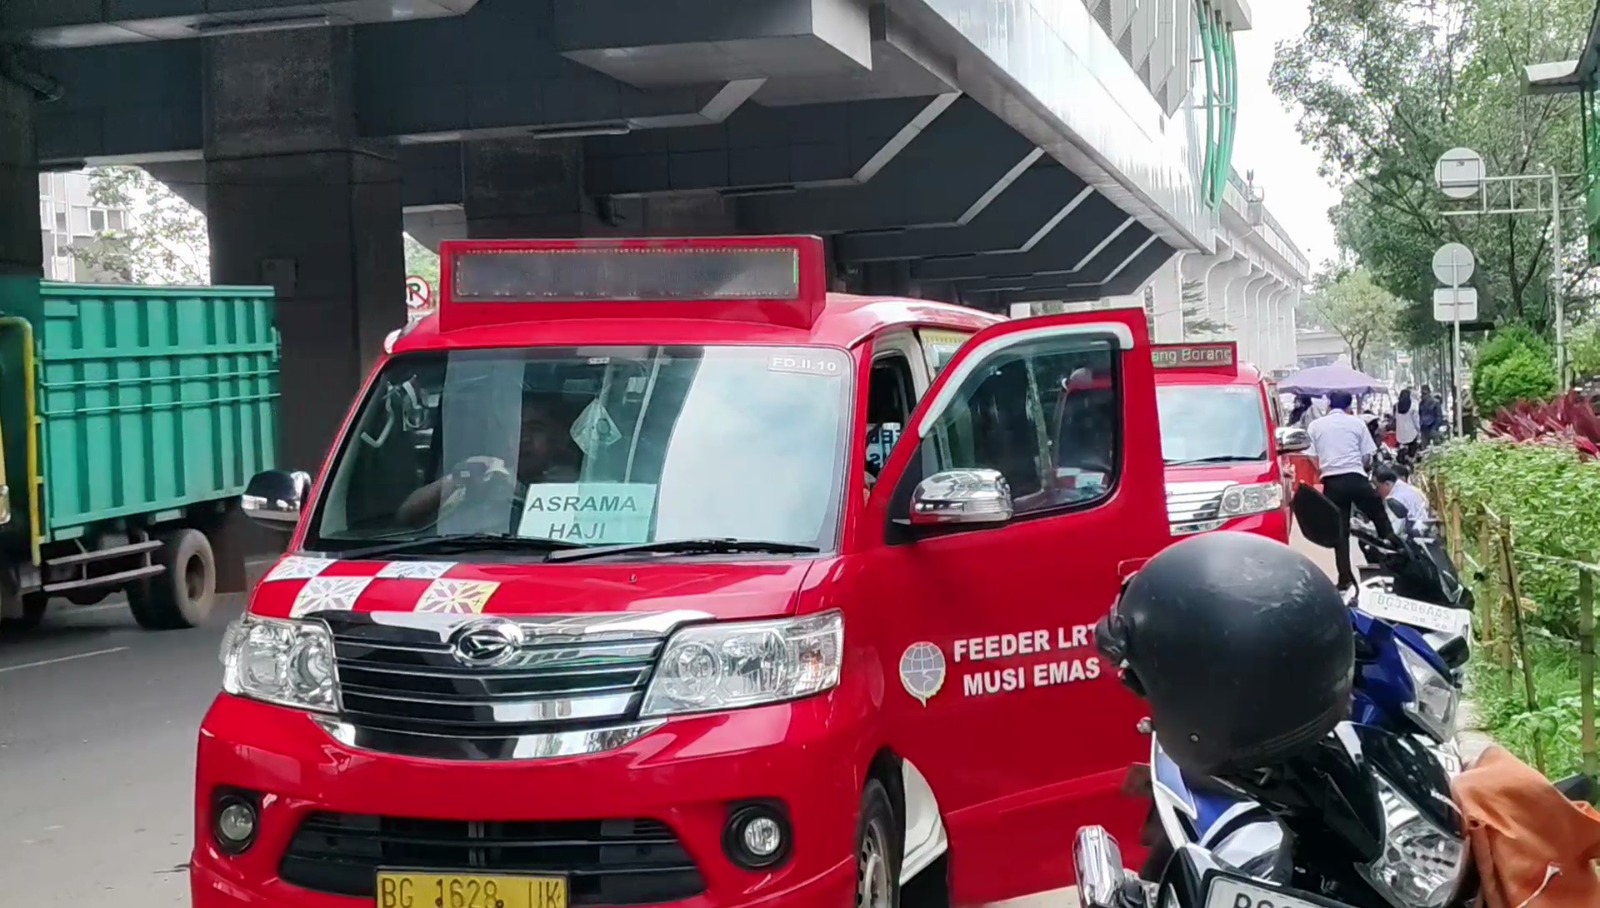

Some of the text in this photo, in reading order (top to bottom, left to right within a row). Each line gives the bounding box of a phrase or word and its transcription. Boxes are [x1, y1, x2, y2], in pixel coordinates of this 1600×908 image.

[1182, 348, 1233, 366] Borang
[528, 495, 637, 512] ASRAMA
[548, 523, 606, 540] HAJI
[953, 623, 1098, 662] FEEDER LRT
[963, 656, 1100, 696] MUSI EMAS
[381, 877, 414, 908] BG
[436, 878, 498, 908] 1628
